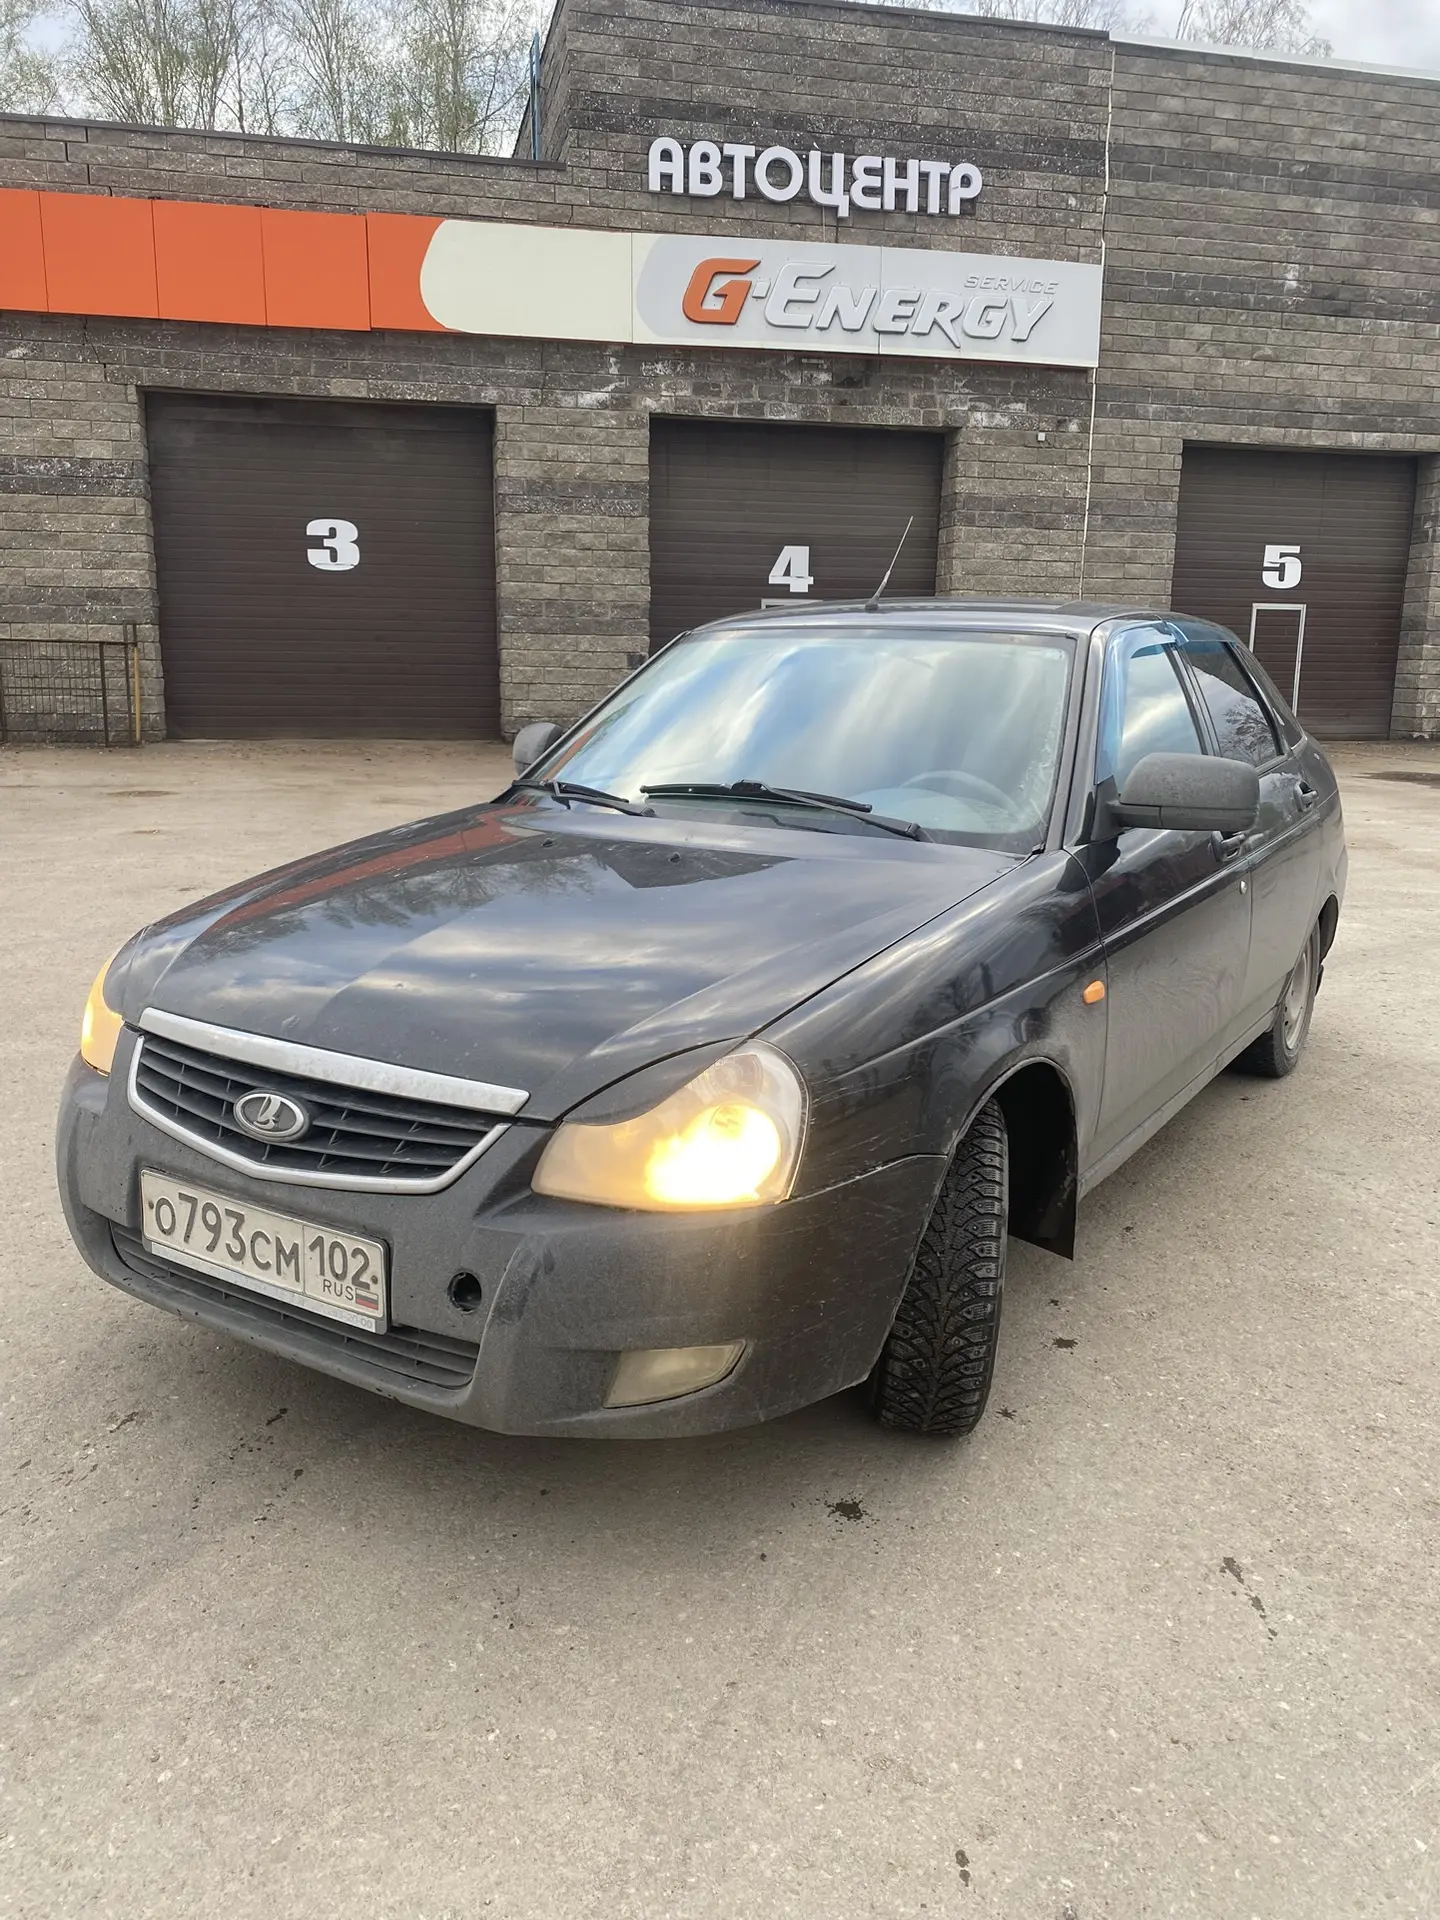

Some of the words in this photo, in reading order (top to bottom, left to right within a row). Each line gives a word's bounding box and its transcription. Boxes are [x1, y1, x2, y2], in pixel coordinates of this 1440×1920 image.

[648, 136, 983, 218] АВТОЦЕНТР
[963, 274, 1059, 295] SERVICE
[306, 518, 360, 571] 3
[1262, 544, 1302, 589] 5
[768, 545, 814, 593] 4
[308, 1235, 371, 1291] 102
[322, 1278, 355, 1302] RUS
